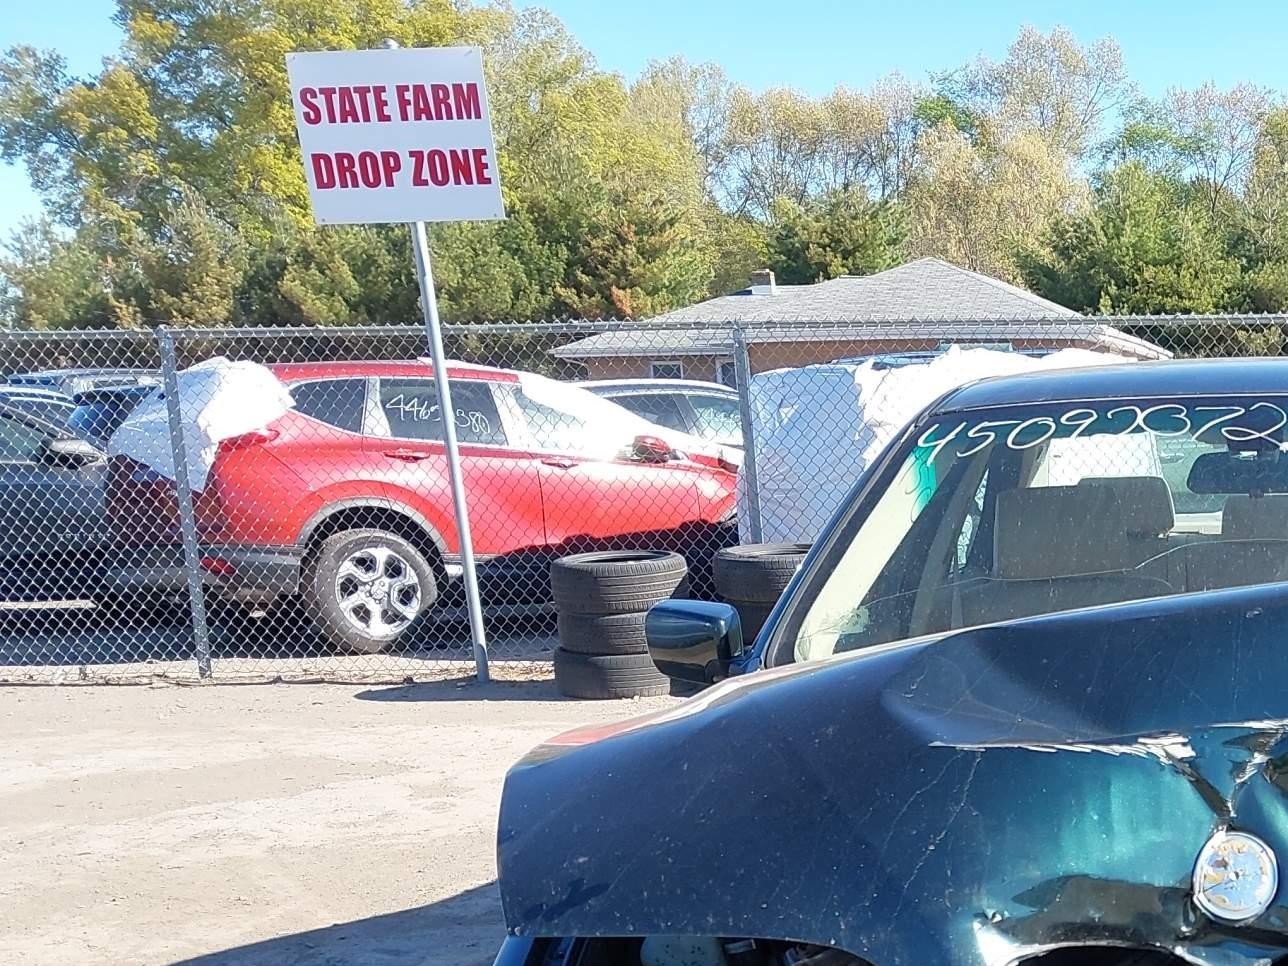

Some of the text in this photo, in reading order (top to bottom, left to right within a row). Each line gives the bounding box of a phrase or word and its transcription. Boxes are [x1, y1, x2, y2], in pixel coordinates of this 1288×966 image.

[300, 83, 482, 125] STATE FARM
[311, 149, 492, 190] DROP ZONE
